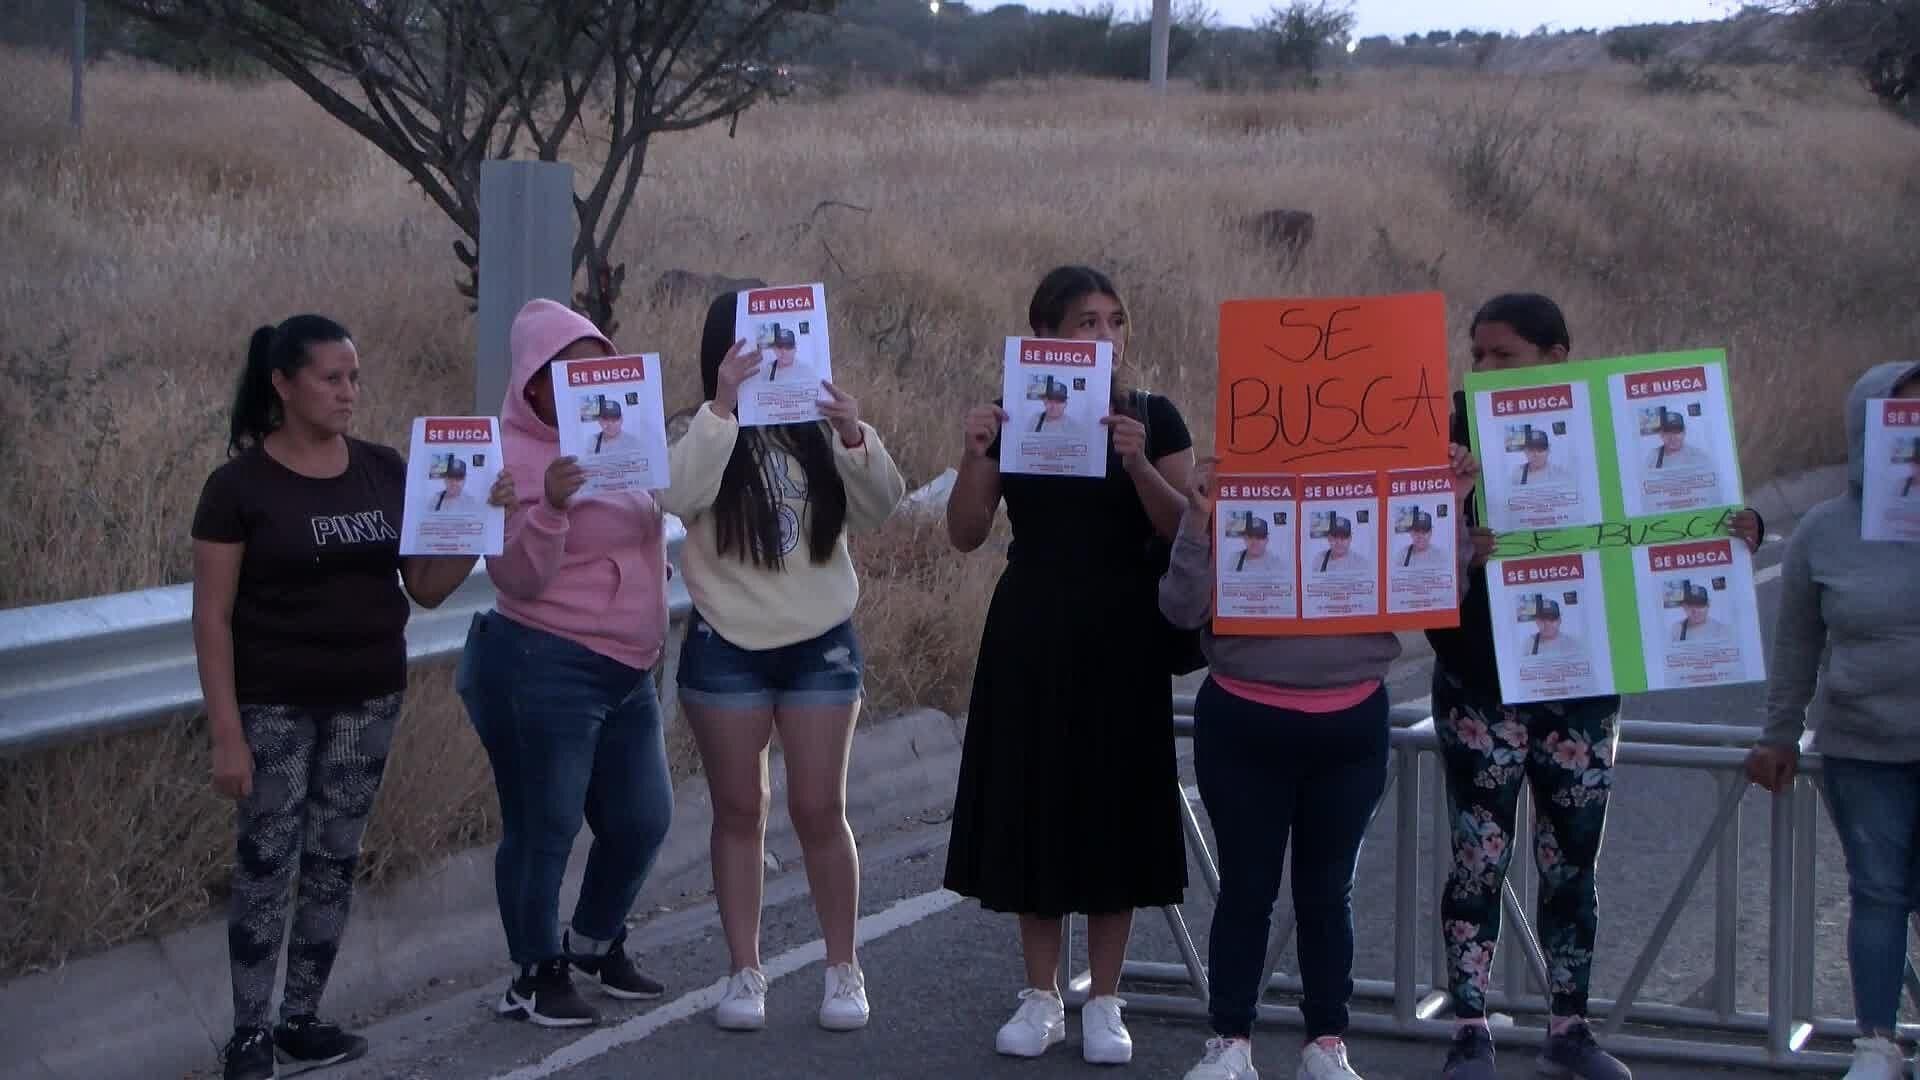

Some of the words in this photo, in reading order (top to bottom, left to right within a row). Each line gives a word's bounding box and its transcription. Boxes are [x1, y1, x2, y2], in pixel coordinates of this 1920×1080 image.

[751, 299, 766, 312] SE
[769, 296, 811, 310] BUSCA
[1264, 305, 1373, 363] SE
[1024, 350, 1041, 361] SE
[1045, 351, 1092, 364] BUSCA
[571, 371, 589, 384] SE
[592, 367, 641, 382] BUSCA
[1630, 383, 1649, 396] SE
[1652, 377, 1703, 393] BUSCA
[1228, 363, 1444, 455] BUSCA
[1496, 400, 1514, 414] SE
[1518, 394, 1569, 410] BUSCA
[1887, 411, 1905, 425] SE
[428, 428, 444, 441] SE
[447, 429, 490, 441] BUSCA
[1220, 485, 1238, 498] SE
[1242, 485, 1292, 498] BUSCA
[1304, 485, 1322, 498] SE
[1326, 483, 1374, 498] BUSCA
[1391, 481, 1407, 494] SE
[1410, 478, 1451, 492] BUSCA
[311, 509, 399, 545] PINK
[1491, 529, 1584, 557] SE
[1654, 555, 1672, 569] SE
[1676, 549, 1729, 566] BUSCA
[1507, 569, 1527, 583] SE
[1529, 565, 1580, 581] BUSCA
